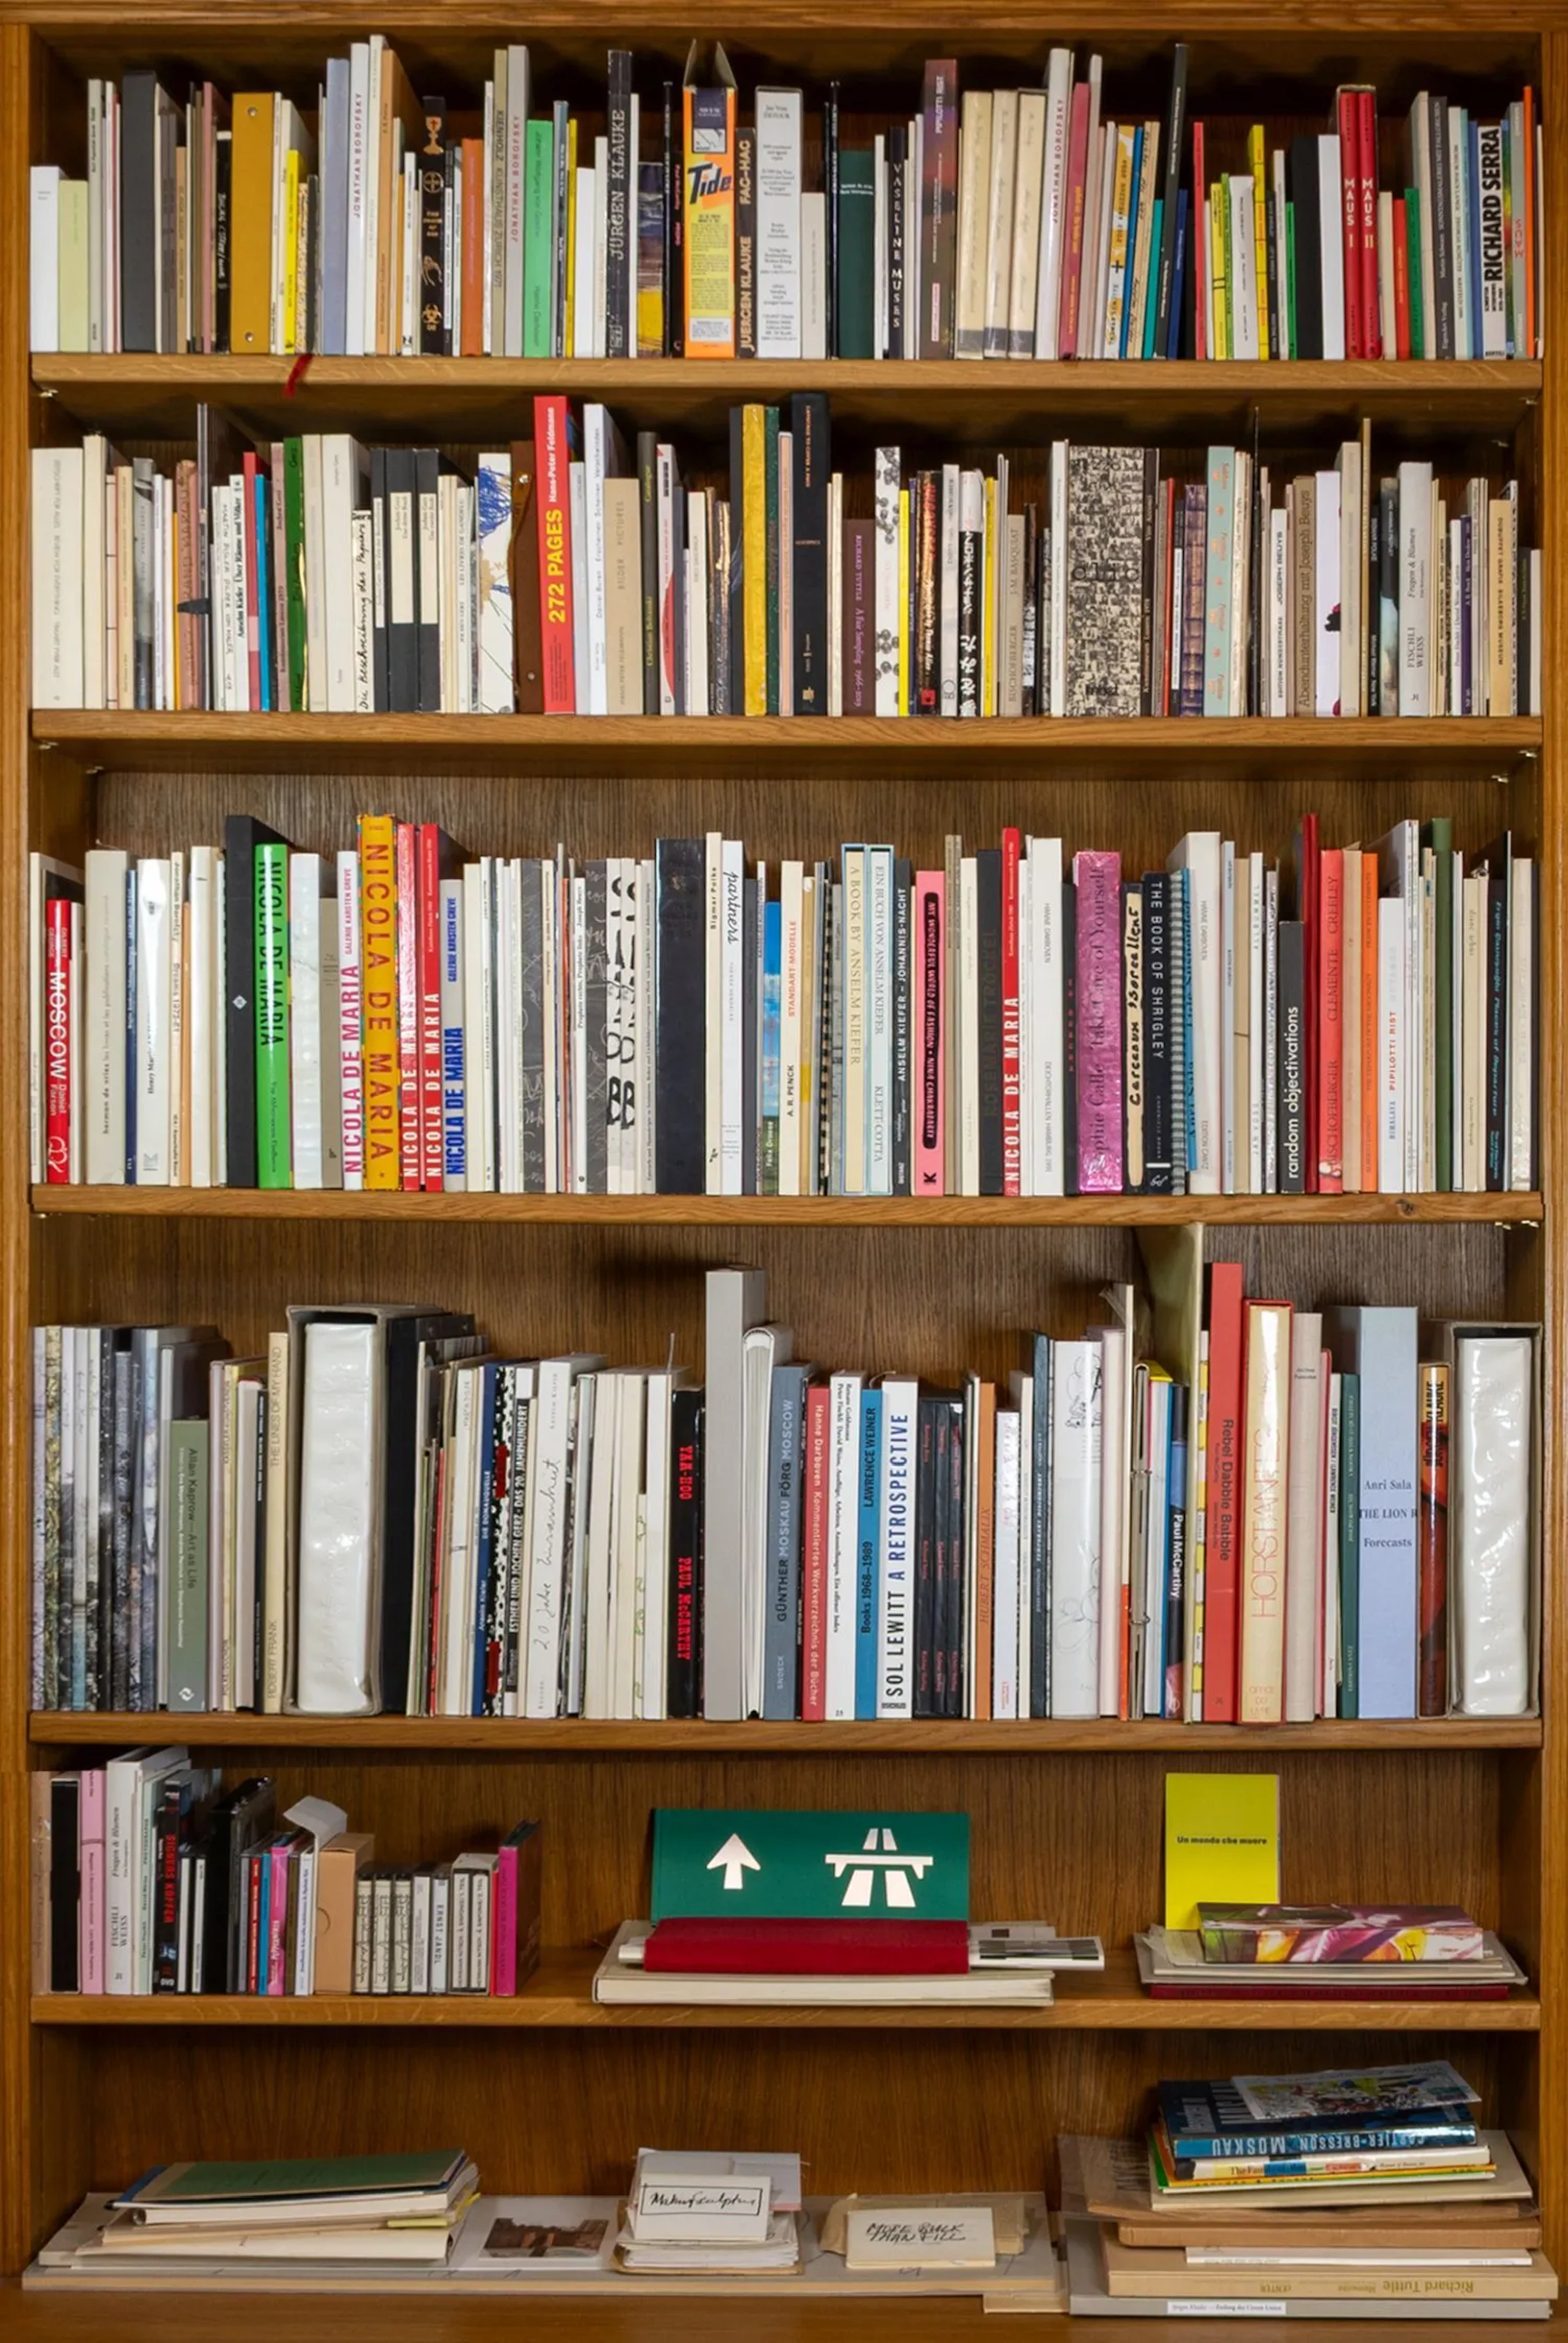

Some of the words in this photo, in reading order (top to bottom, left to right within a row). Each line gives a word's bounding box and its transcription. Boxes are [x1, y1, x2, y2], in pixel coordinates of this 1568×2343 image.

[936, 76, 944, 94] RIST
[495, 110, 504, 161] KIENHOLZ
[611, 109, 626, 180] KLAUKE
[1054, 99, 1064, 159] BOROFSKY
[739, 140, 752, 204] FAC-HAC
[1483, 129, 1501, 190] SERRA
[494, 167, 503, 228] KUNSTHAUS
[687, 161, 732, 205] Tide
[1051, 163, 1060, 224] JONATHAN
[1345, 178, 1354, 226] MAUS
[1362, 178, 1373, 227] MAUS
[608, 190, 625, 260] JÜRGEN
[892, 163, 903, 260] VASELINE
[1483, 195, 1502, 281] RICHARD
[739, 236, 752, 288] KLAUKE
[891, 269, 903, 328] MUSES
[739, 290, 755, 351] JUERGEN
[546, 407, 555, 450] Feldmann
[548, 453, 558, 502] Hans-Peter
[233, 497, 242, 519] Völker
[1298, 490, 1311, 524] Beuys
[234, 538, 243, 562] Räume
[546, 509, 564, 576] PAGES
[1298, 529, 1313, 570] Joseph
[233, 565, 243, 582] Über
[357, 572, 366, 591] des
[1298, 572, 1309, 590] mit
[235, 586, 244, 609] Kiefer
[548, 583, 566, 623] 272
[236, 611, 245, 637] Anselm
[1298, 595, 1312, 707] Abendunterhaltung
[359, 689, 369, 709] Die
[343, 868, 352, 890] GREVE
[850, 866, 860, 874] A
[344, 892, 352, 923] KARSTEN
[367, 843, 390, 965] NICOLA
[723, 871, 739, 945] partners
[850, 879, 861, 921] BOOK
[927, 902, 936, 915] MY
[1150, 882, 1163, 908] THE
[345, 925, 353, 954] GALERIE
[850, 925, 861, 942] BY
[927, 919, 936, 968] WONDERFUL
[1151, 916, 1163, 954] BOOK
[850, 949, 861, 1009] ANSELM
[927, 970, 935, 998] WORLD
[1151, 962, 1163, 979] OF
[341, 965, 359, 1040] MARIA
[369, 992, 391, 1030] DE
[898, 995, 906, 1034] KIEFER
[49, 971, 67, 1079] MOSCOW
[424, 992, 440, 1054] MARIA
[850, 1013, 861, 1065] KIEFER
[925, 1011, 935, 1049] FASHION
[1152, 987, 1164, 1059] SHRIGLEY
[342, 1050, 360, 1078] DE
[445, 1028, 463, 1081] MARIA
[898, 1037, 906, 1081] ANSELM
[1283, 1006, 1301, 1112] objectivations
[425, 1068, 440, 1090] DE
[445, 1089, 463, 1109] DE
[370, 1052, 393, 1159] MARIA
[343, 1087, 362, 1173] NICOLA
[425, 1105, 441, 1177] NICOLA
[445, 1116, 465, 1174] NICOLA
[1285, 1119, 1300, 1178] random
[515, 1404, 528, 1471] JAHRHUNDERT
[782, 1400, 793, 1460] MOSCOW
[814, 1404, 824, 1436] Hanne
[864, 1408, 876, 1448] WEINER
[1223, 1419, 1234, 1457] Rebel
[187, 1448, 198, 1478] Allan
[777, 1463, 792, 1497] FÖRG
[814, 1438, 823, 1487] Darboven
[863, 1451, 875, 1507] LAWRENCE
[514, 1490, 524, 1507] DAS
[889, 1414, 907, 1561] RETROSPECTIVE
[1221, 1462, 1233, 1509] Dabble
[1364, 1479, 1385, 1491] Anri
[1390, 1480, 1412, 1490] Sala
[779, 1500, 791, 1556] MOSKAU
[812, 1491, 822, 1566] Kommentiertes
[1174, 1514, 1183, 1538] Paul
[1382, 1508, 1408, 1519] LION
[187, 1552, 197, 1562] as
[1219, 1514, 1232, 1561] Babble
[1363, 1537, 1412, 1548] Forecasts
[187, 1563, 197, 1588] Life
[511, 1541, 522, 1575] JOCHEN
[679, 1557, 691, 1588] PAUL
[889, 1571, 905, 1581] A
[1171, 1541, 1182, 1598] McCarthy
[510, 1578, 521, 1598] UND
[775, 1559, 789, 1621] GÜNTHER
[509, 1601, 520, 1632] ESTHER
[677, 1594, 692, 1660] McCARTHY
[811, 1568, 822, 1649] Werkverzeichnis
[861, 1602, 871, 1633] Books
[888, 1591, 905, 1656] LEWITT
[811, 1652, 820, 1668] der
[809, 1671, 820, 1706] Bücher
[887, 1664, 904, 1697] SOL
[165, 1834, 175, 1878] SIGNERS
[164, 1884, 174, 1923] KOFFER
[434, 1937, 443, 1964] JANDL
[1212, 2137, 1285, 2156] MOSKAU
[1299, 2133, 1424, 2150] CARTIER-BRESSON
[1383, 2281, 1420, 2293] Tuttle
[1425, 2281, 1474, 2293] Richard
